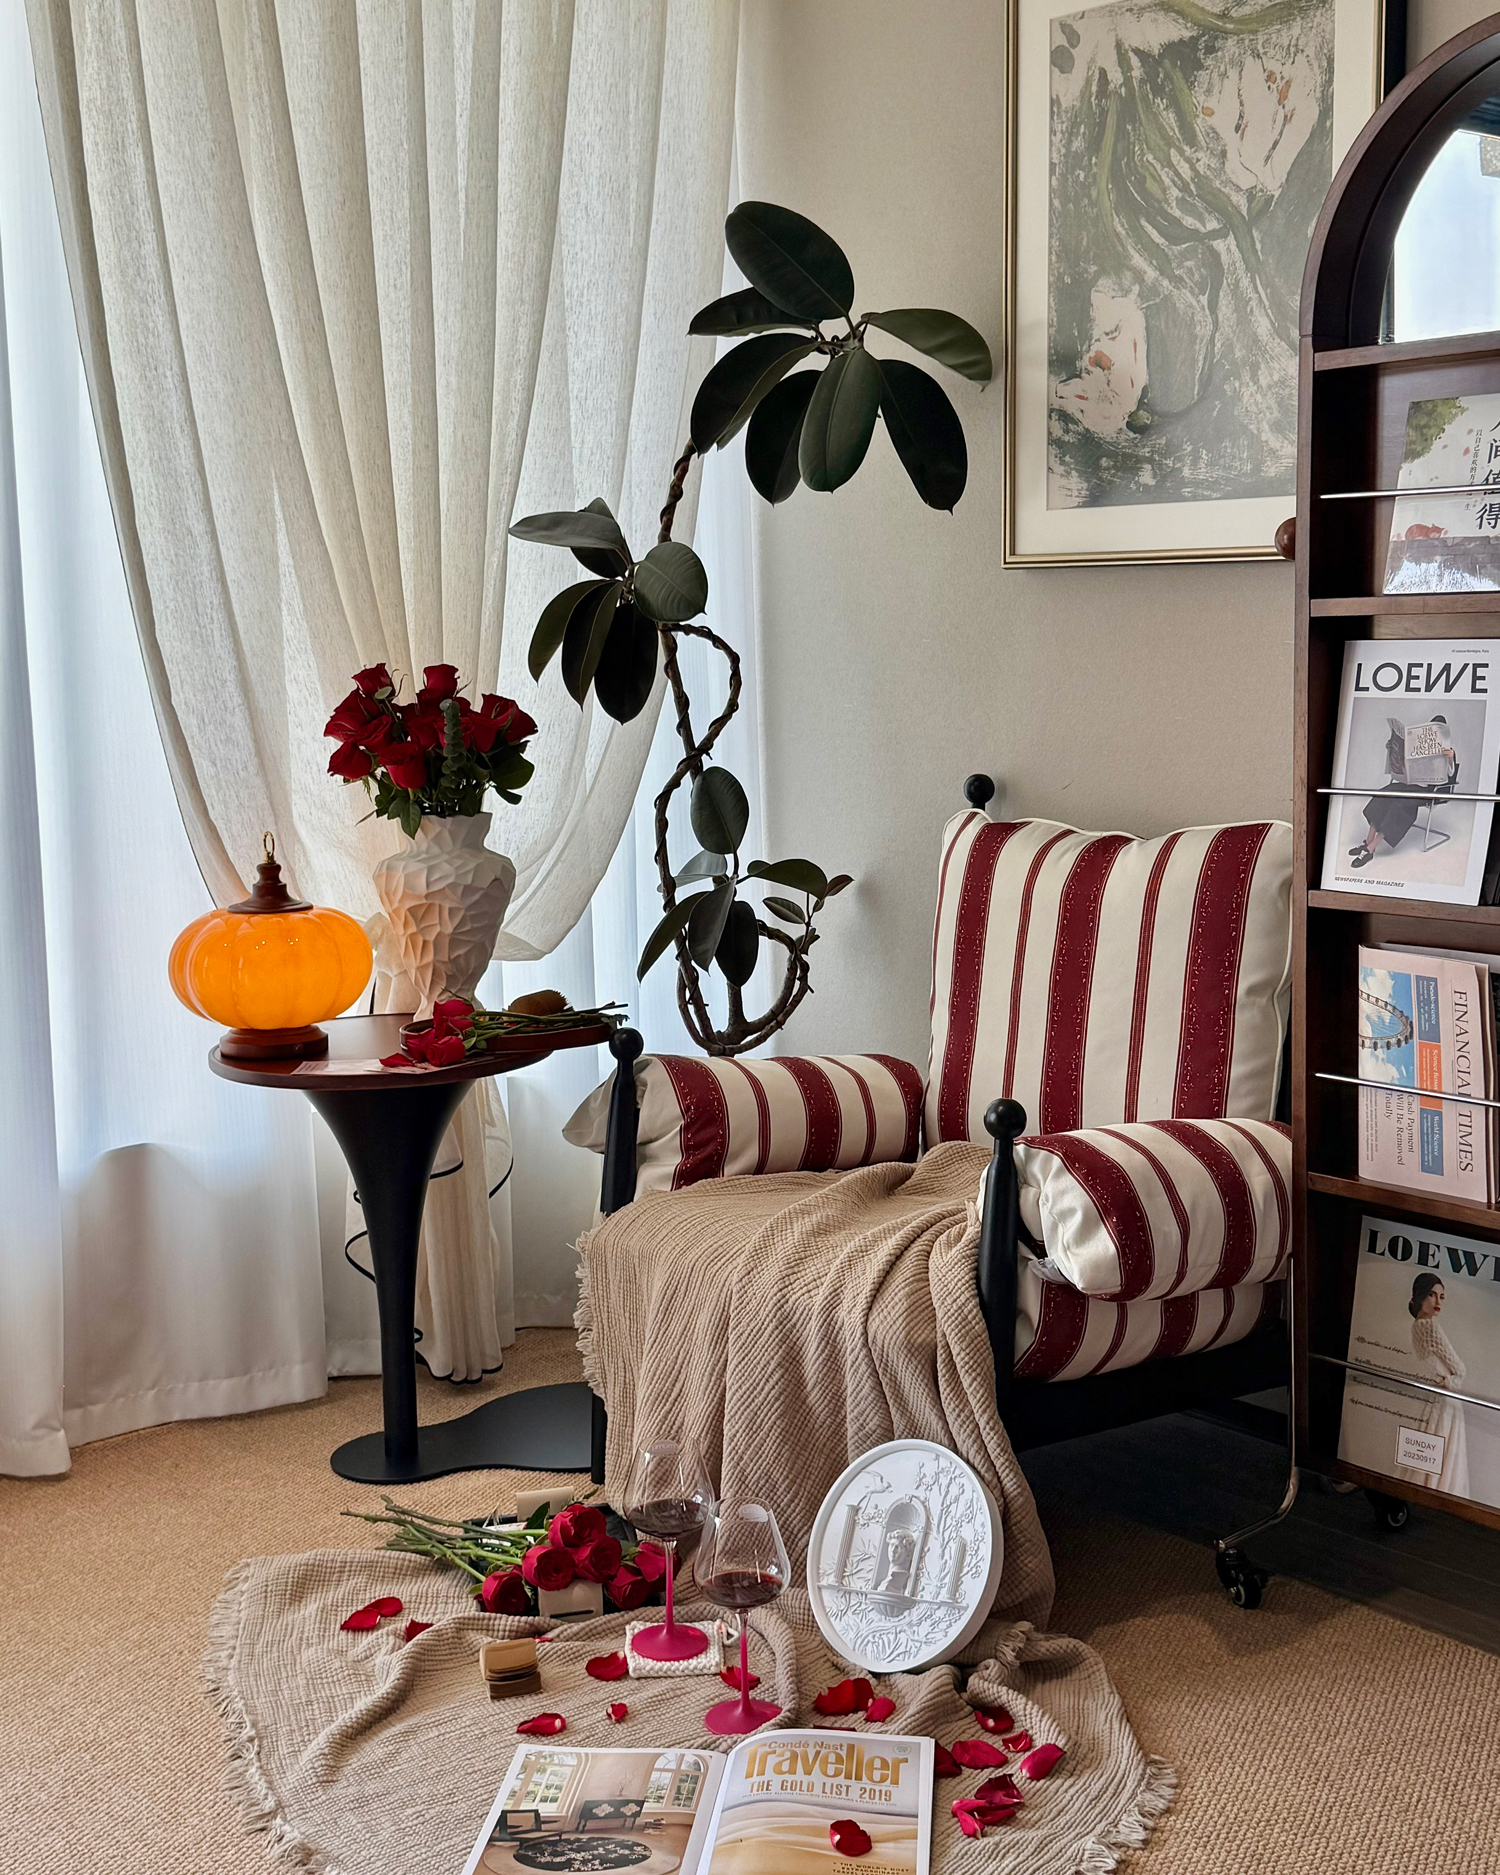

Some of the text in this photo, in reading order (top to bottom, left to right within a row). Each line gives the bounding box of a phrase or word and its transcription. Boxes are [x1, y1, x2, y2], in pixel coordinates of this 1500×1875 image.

[1354, 662, 1490, 694] LOEWE
[1376, 880, 1405, 888] MAGAZINES
[1383, 1091, 1394, 1121] Totally
[1396, 1093, 1406, 1166] Will Be Removed
[1405, 1094, 1415, 1153] Cash Payment
[1458, 1109, 1474, 1173] TIMES
[1403, 1450, 1437, 1465] 20230917
[1404, 1437, 1437, 1451] SUNDAY
[767, 1740, 845, 1751] Condé Nast
[742, 1742, 909, 1786] Traveller
[749, 1778, 892, 1802] THE GOLD LIST 2019
